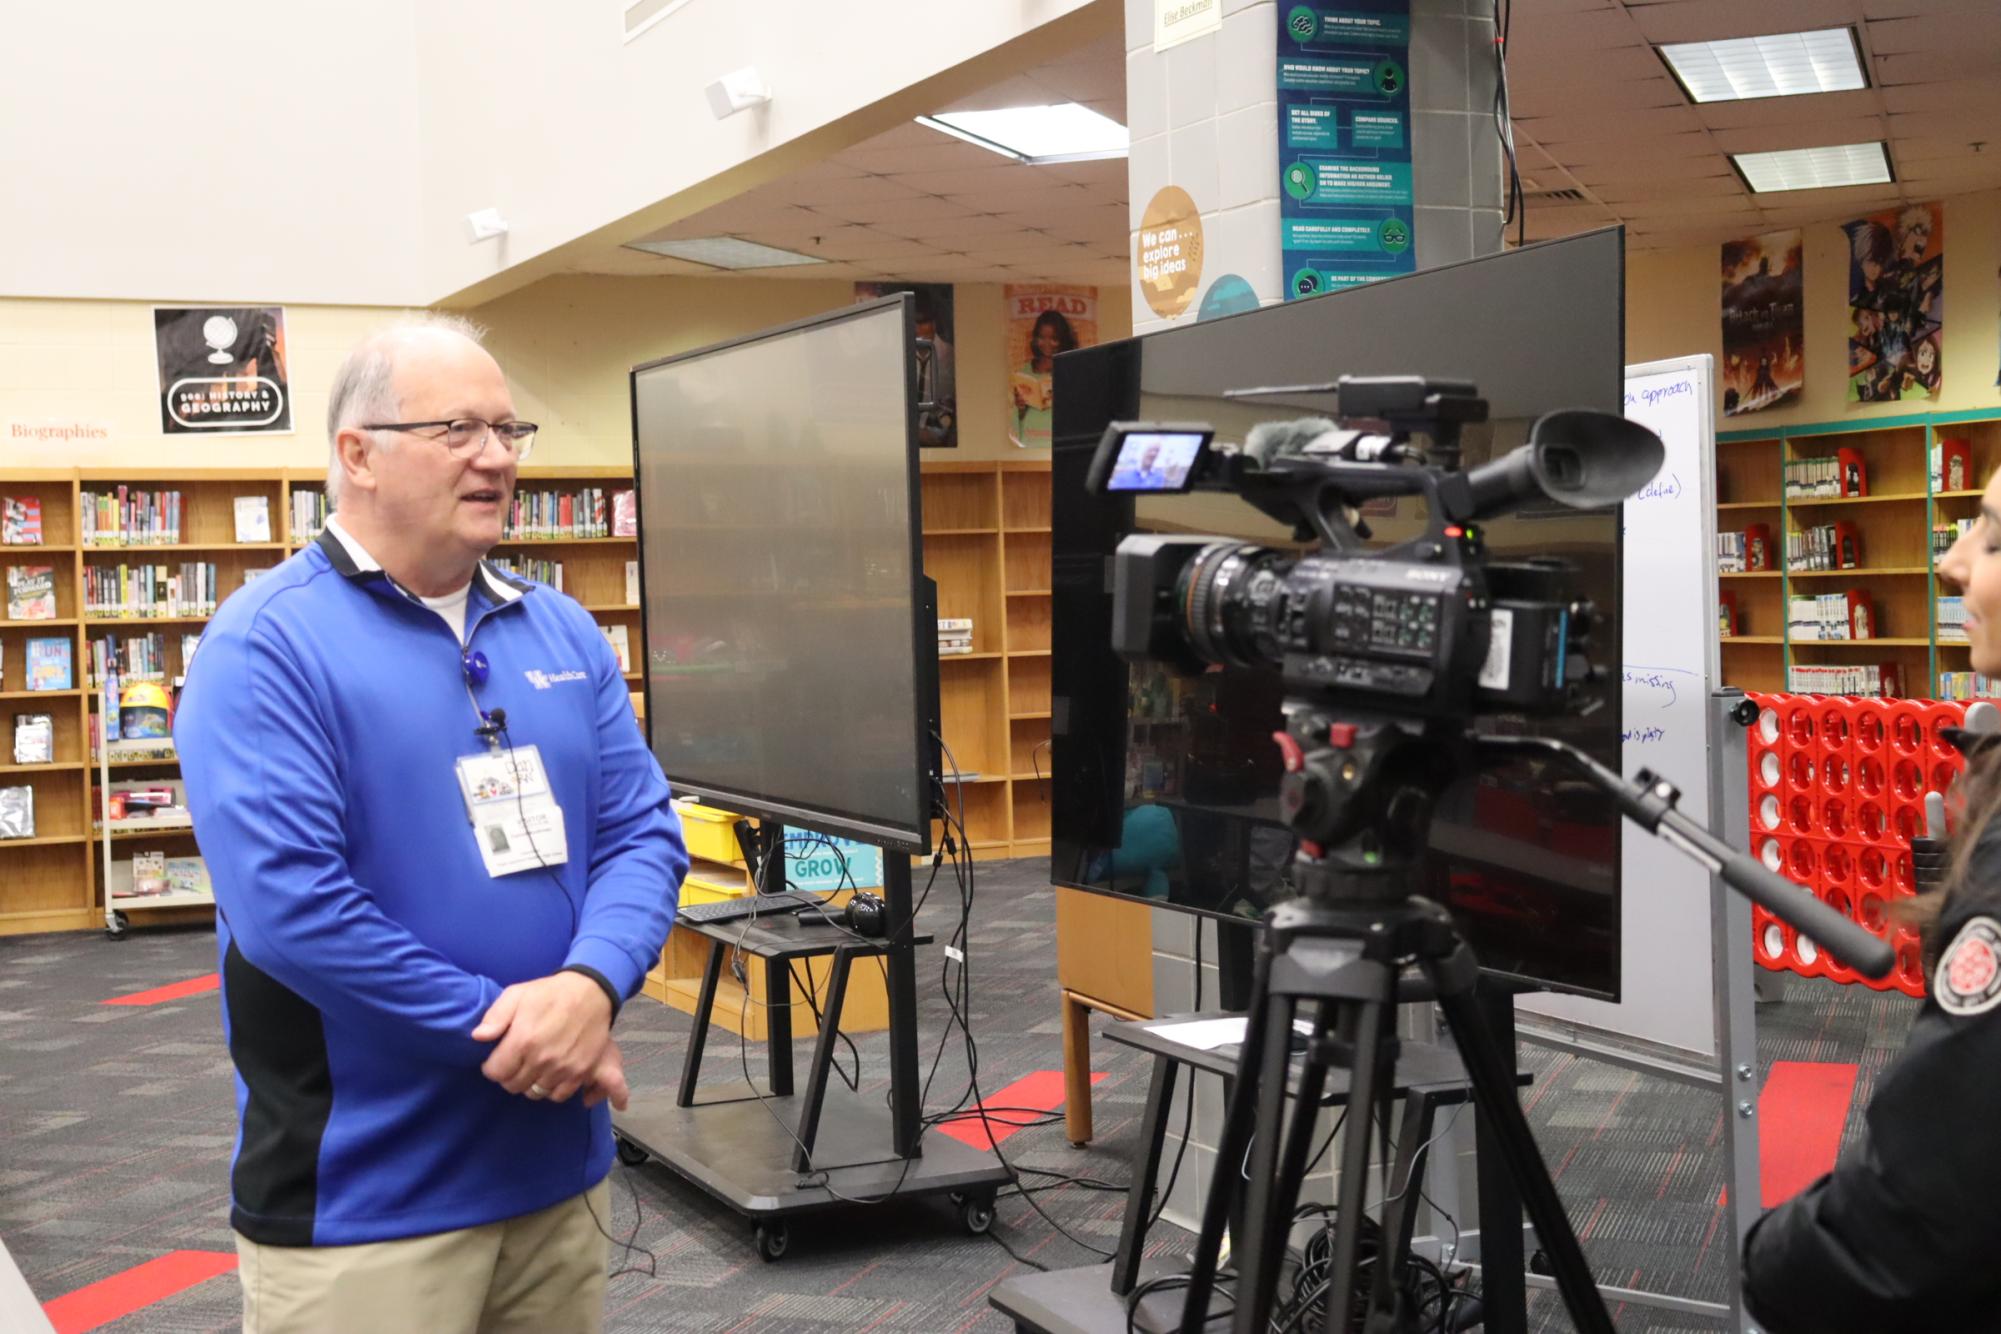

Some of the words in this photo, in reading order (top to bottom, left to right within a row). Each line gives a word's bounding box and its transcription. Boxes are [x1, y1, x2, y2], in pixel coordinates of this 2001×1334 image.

[1142, 232, 1157, 247] We
[1143, 244, 1180, 264] explore
[1143, 262, 1159, 280] big
[1160, 259, 1187, 275] ideas
[1018, 297, 1087, 314] READ
[209, 391, 257, 400] HISTORY
[261, 389, 269, 399] &
[1641, 380, 1693, 407] approach
[181, 401, 270, 413] GEOGRAPHY
[12, 423, 108, 441] Biographies
[795, 857, 851, 877] GROW
